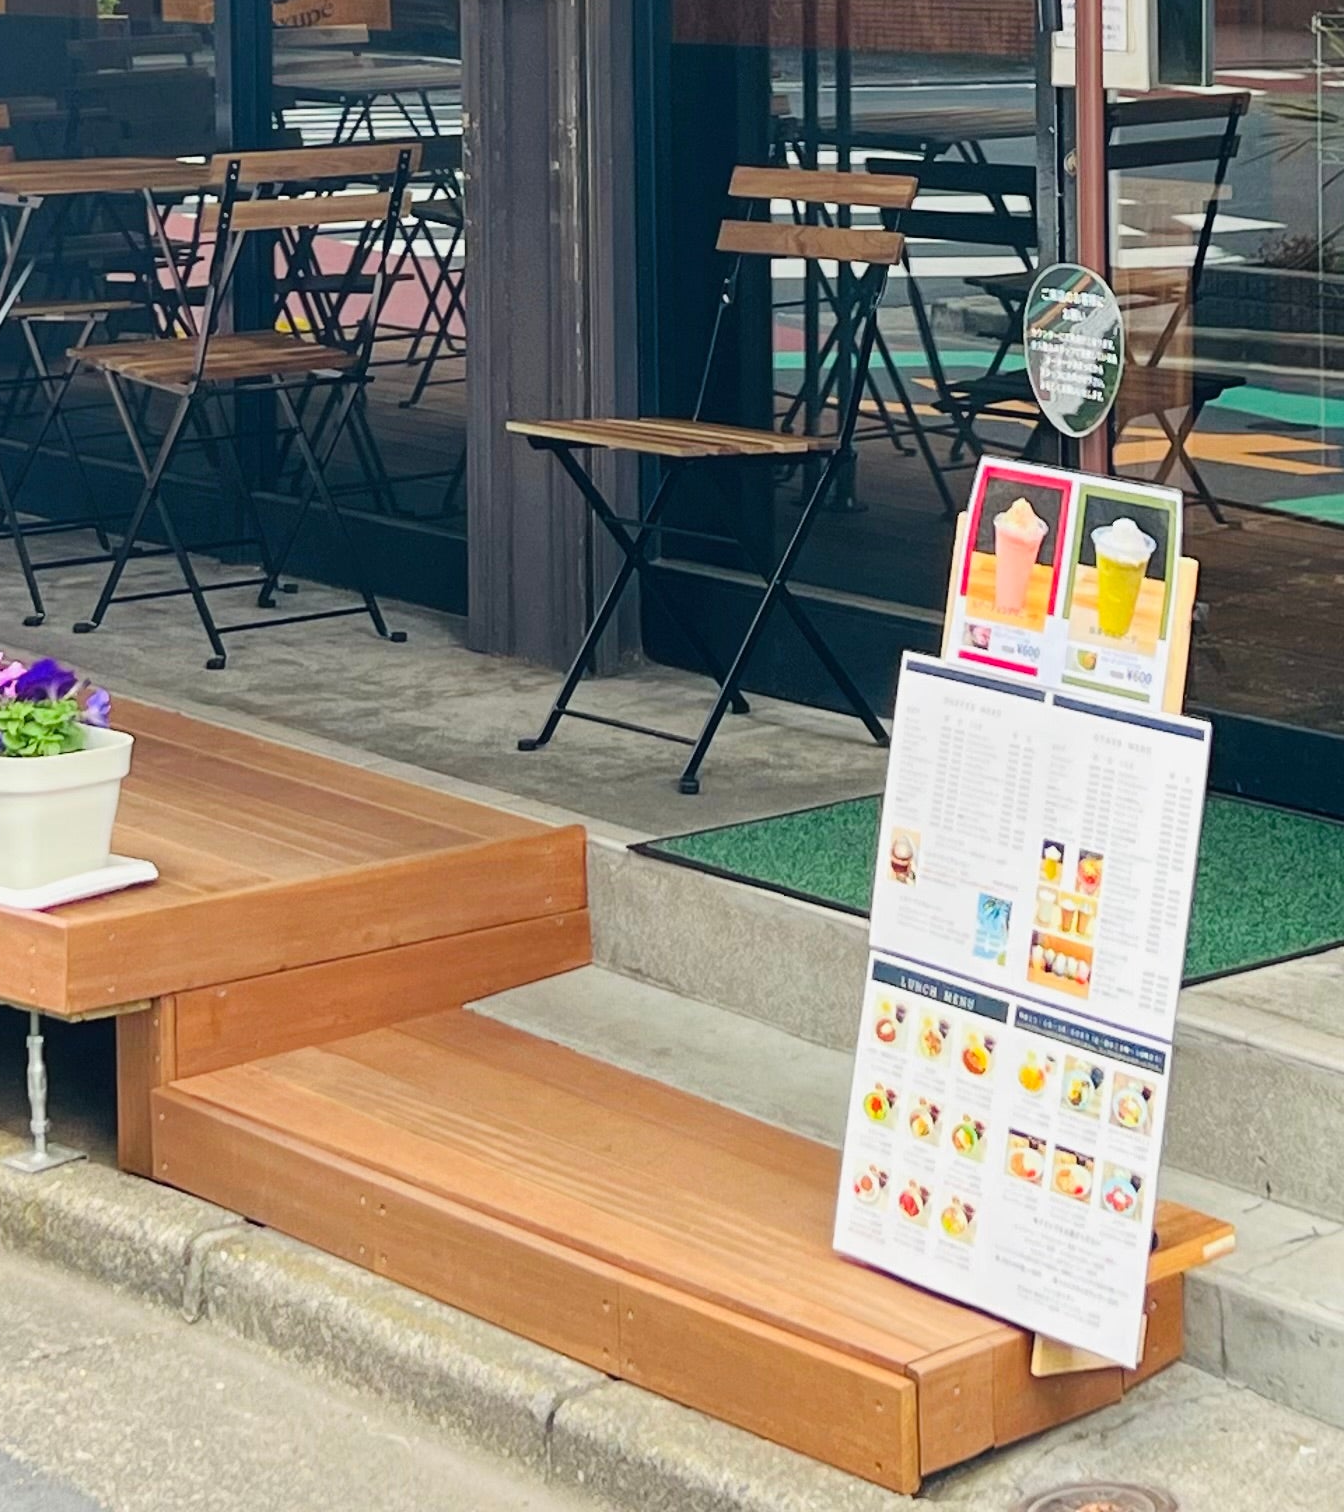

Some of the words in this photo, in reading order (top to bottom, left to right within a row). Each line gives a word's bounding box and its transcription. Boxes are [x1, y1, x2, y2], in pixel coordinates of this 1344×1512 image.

[1016, 642, 1041, 660] ¥600
[1126, 668, 1153, 686] ¥600
[900, 975, 938, 998] LUNCH
[943, 989, 976, 1010] MENU
